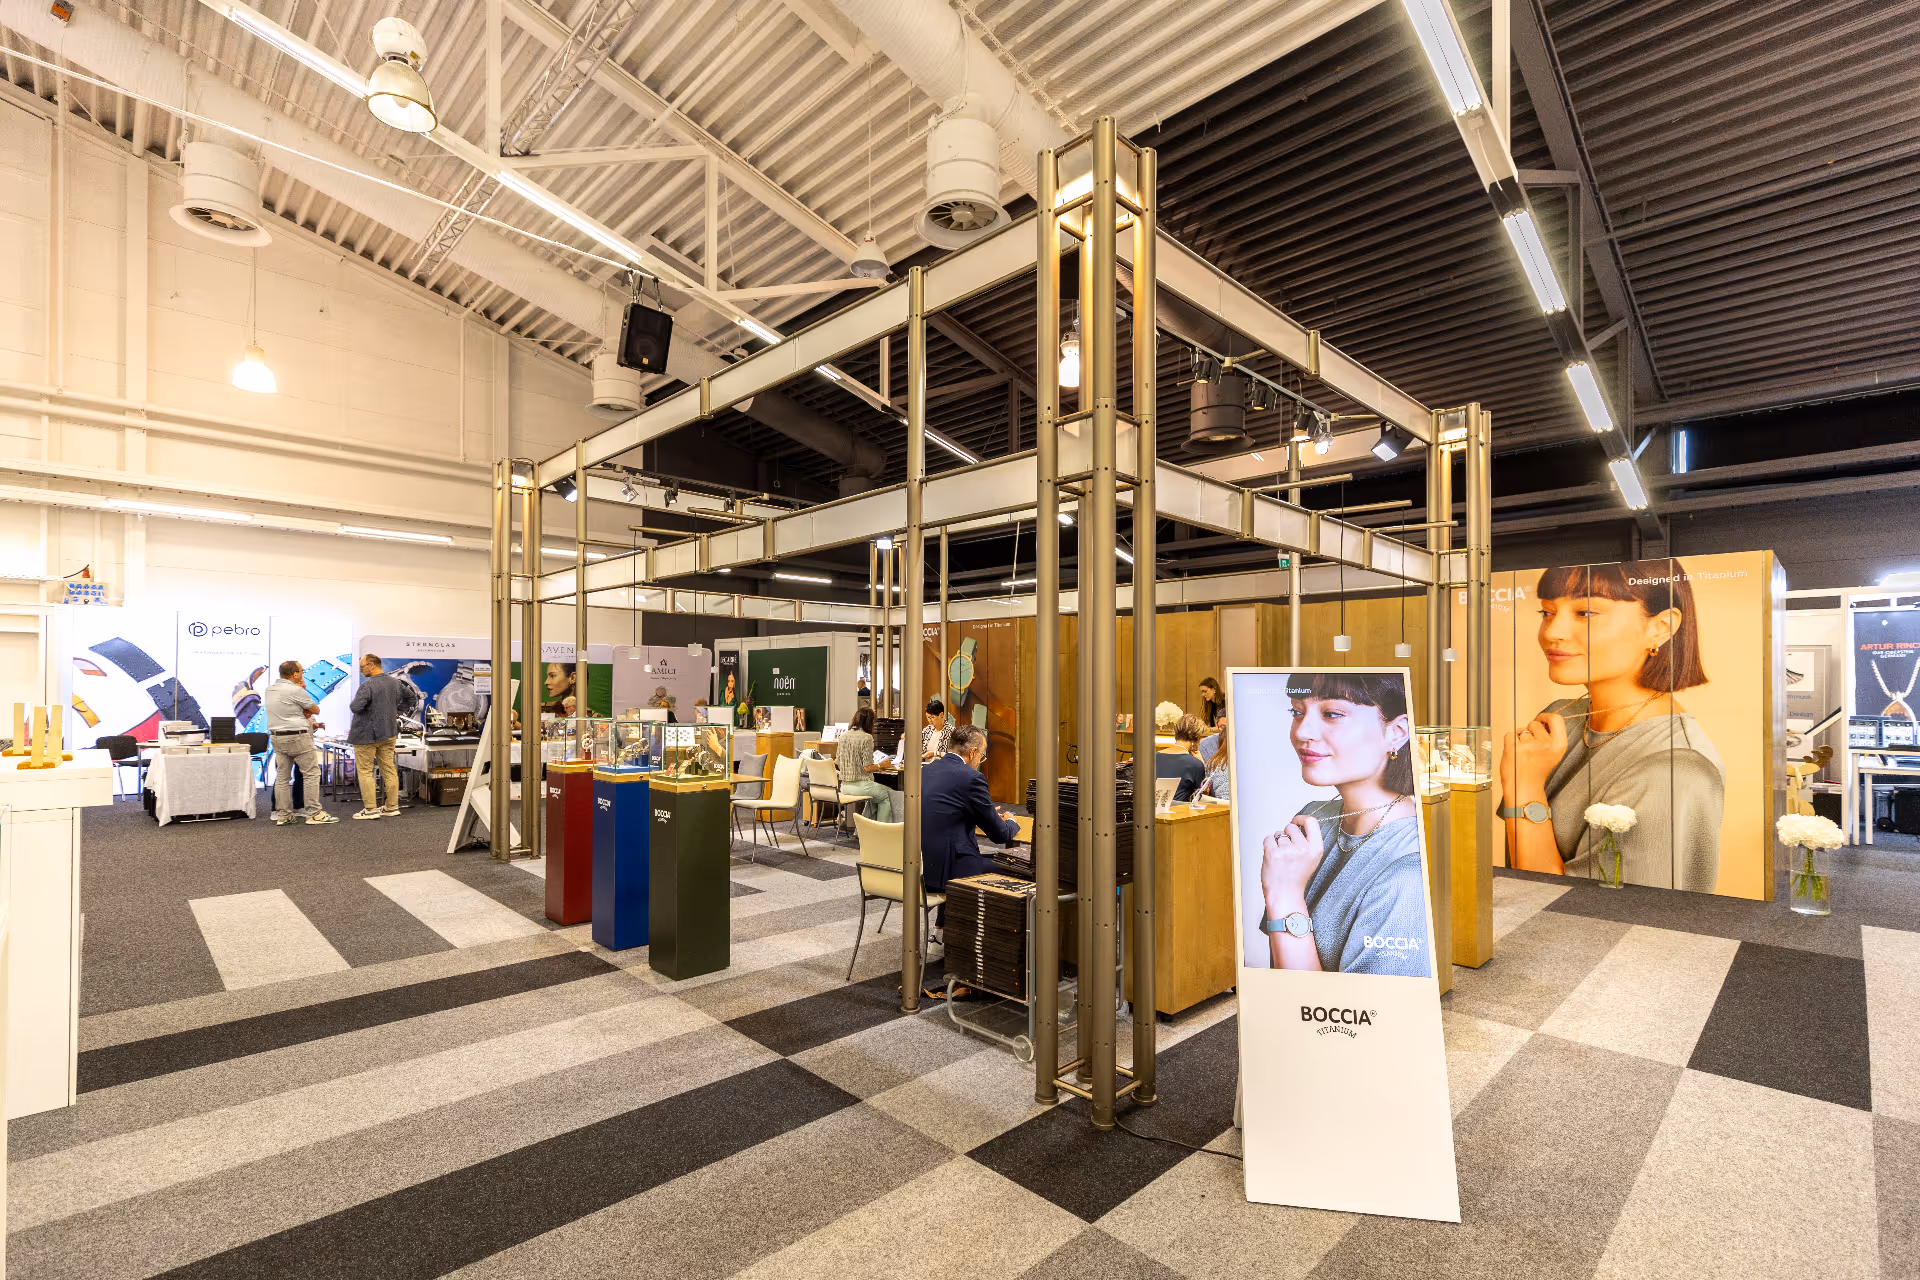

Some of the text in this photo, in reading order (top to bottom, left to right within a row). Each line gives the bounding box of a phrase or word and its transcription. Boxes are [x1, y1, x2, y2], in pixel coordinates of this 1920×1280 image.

[1627, 569, 1748, 586] Designed in Titanium
[211, 623, 261, 637] pebro
[1860, 643, 1894, 651] ARTUR
[1316, 1025, 1358, 1039] TITANIUM
